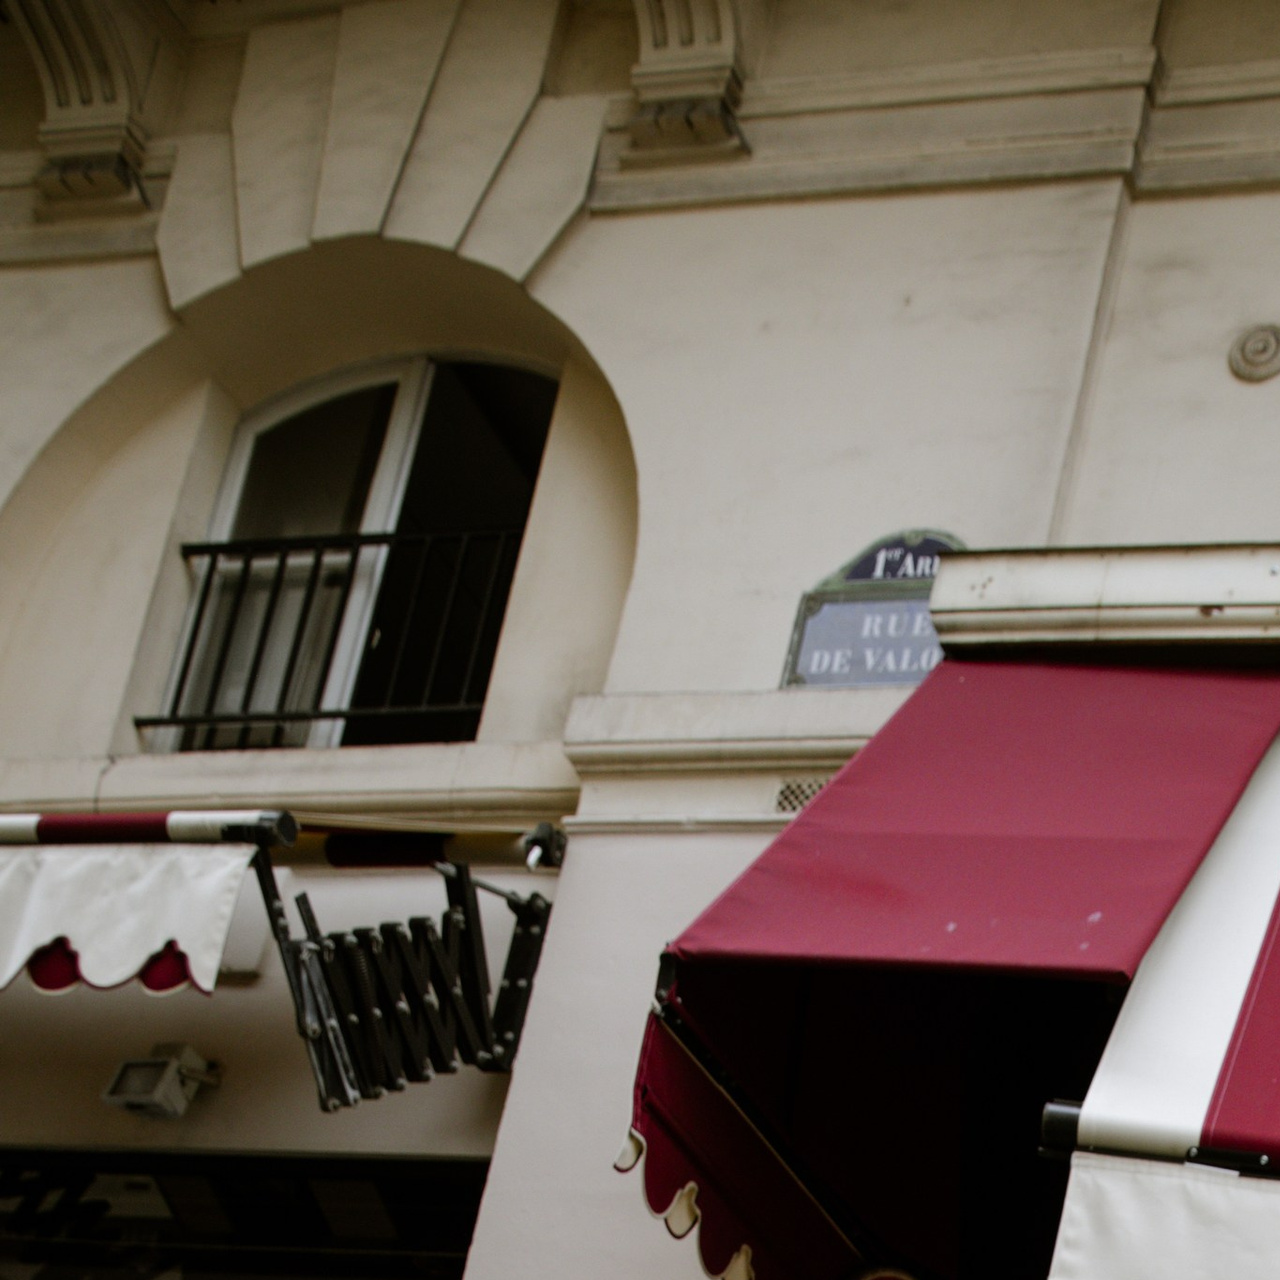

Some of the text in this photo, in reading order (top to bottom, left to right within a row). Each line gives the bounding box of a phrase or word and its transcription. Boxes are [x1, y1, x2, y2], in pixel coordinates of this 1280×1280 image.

[861, 612, 933, 639] RUE
[809, 646, 941, 675] DE VALO
